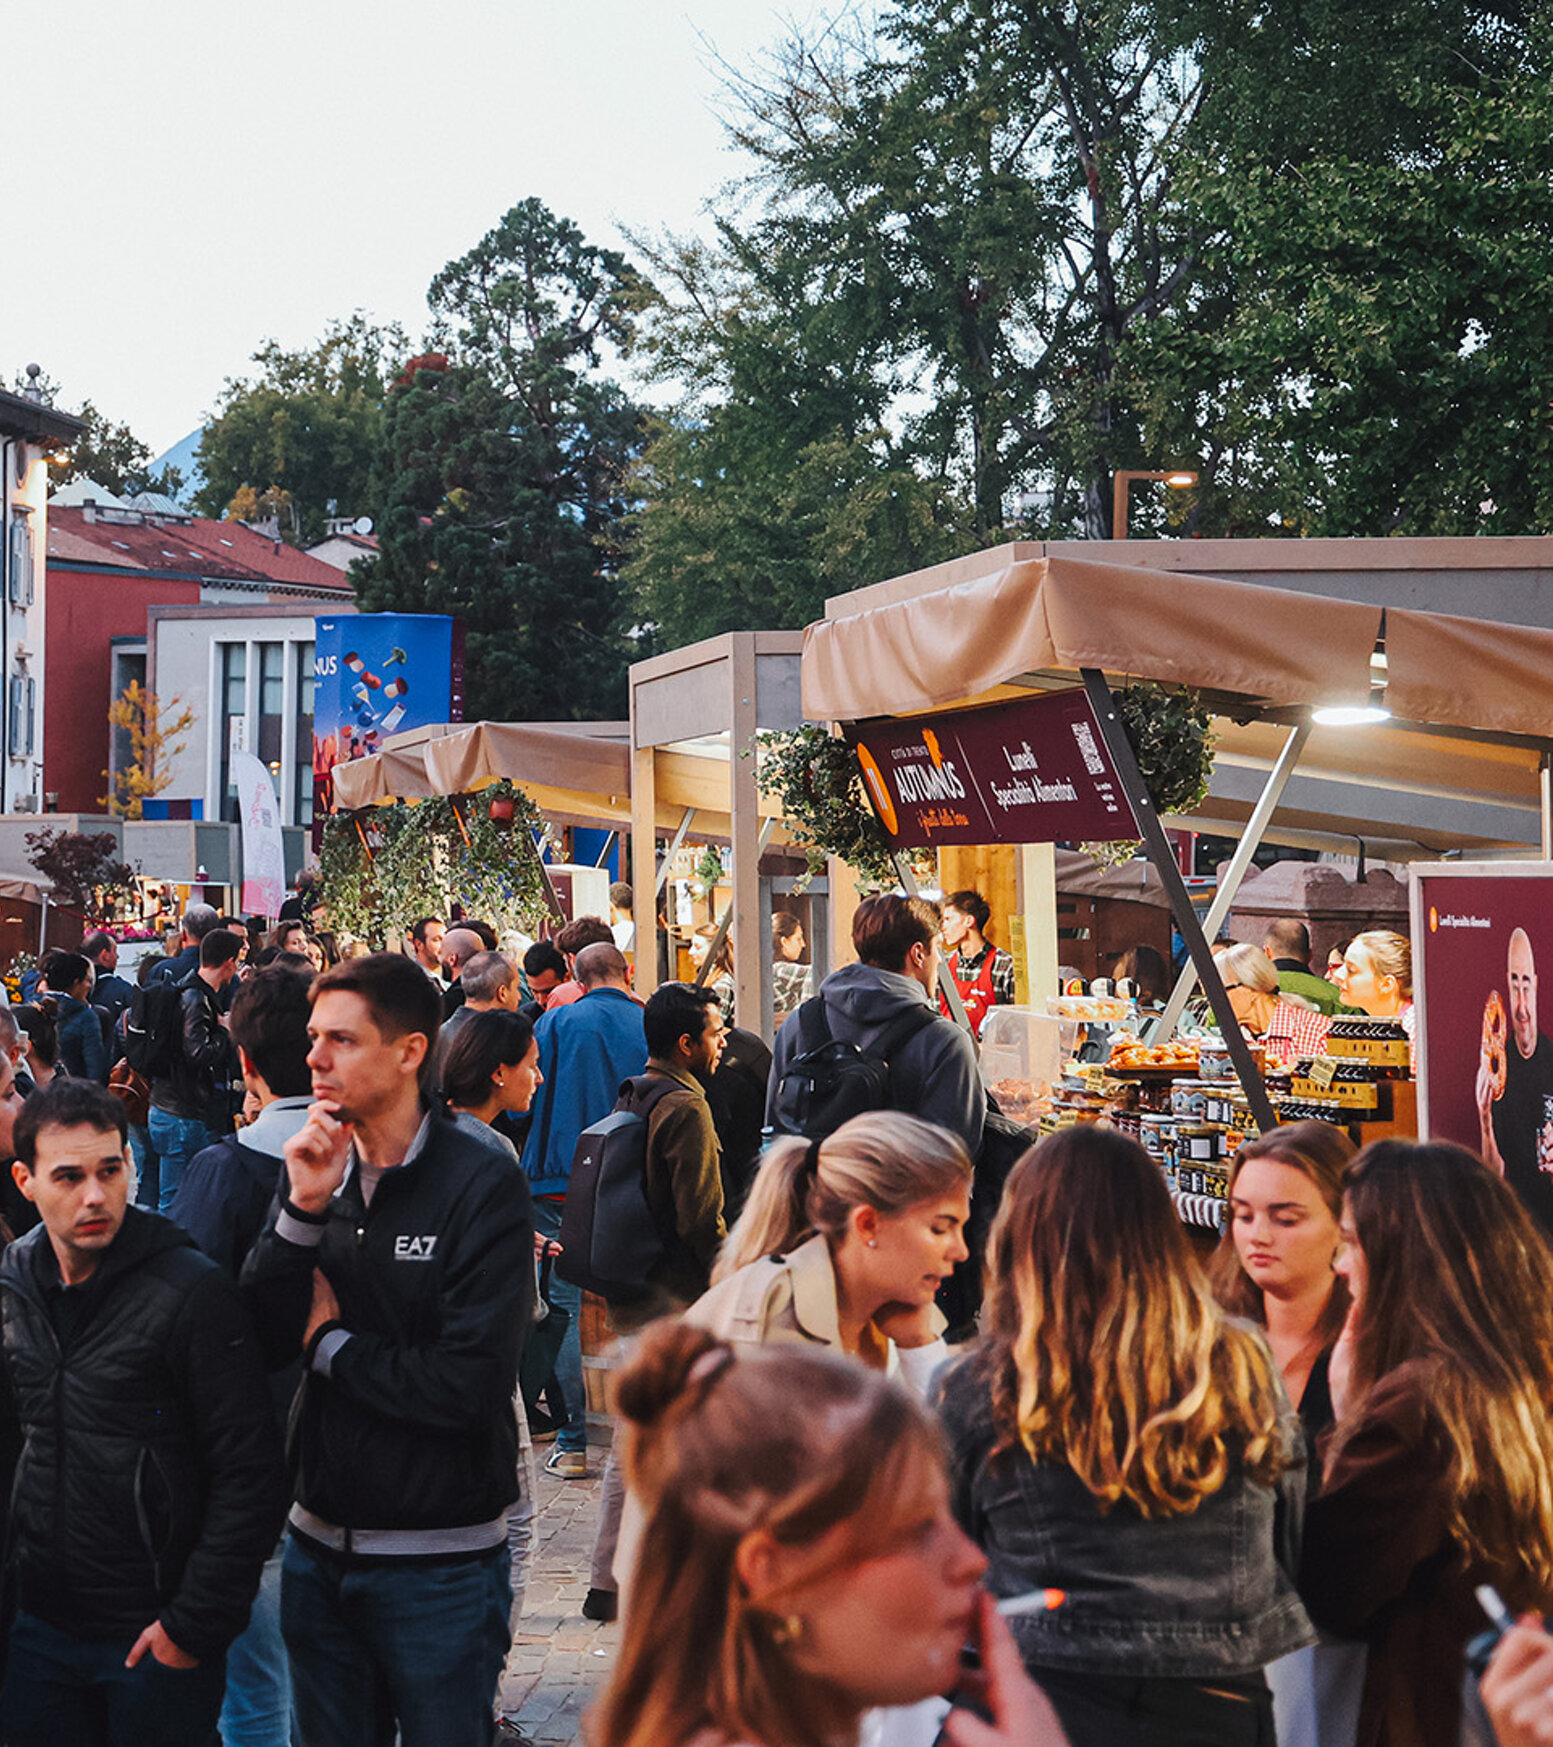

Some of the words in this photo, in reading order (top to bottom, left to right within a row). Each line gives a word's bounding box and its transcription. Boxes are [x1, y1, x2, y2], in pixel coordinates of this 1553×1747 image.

[1002, 740, 1039, 772] Lunelli
[892, 760, 966, 804] AUTUMNUS
[1031, 774, 1079, 803] Alimentari
[394, 1235, 438, 1255] EA7
